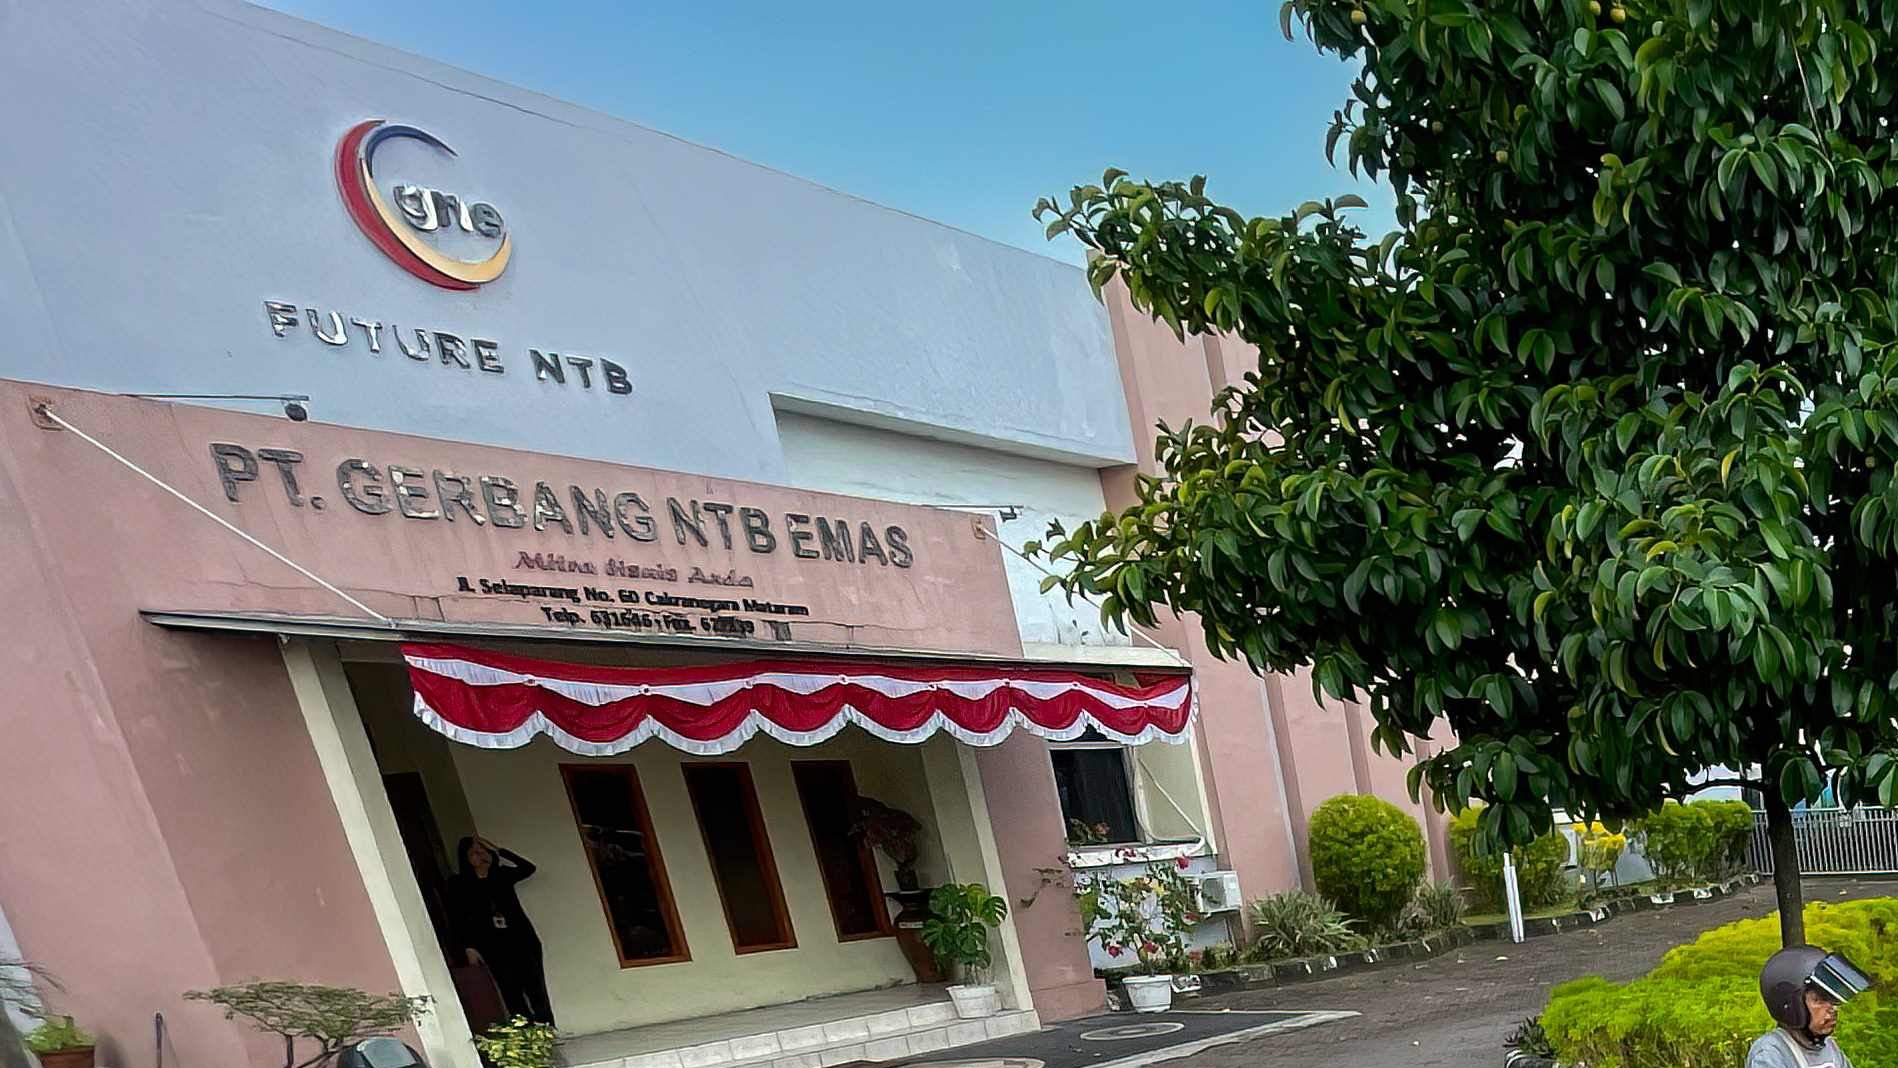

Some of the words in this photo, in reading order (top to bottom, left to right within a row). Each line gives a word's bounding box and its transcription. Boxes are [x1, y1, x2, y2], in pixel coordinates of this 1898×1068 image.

[264, 299, 505, 374] FUTURE
[529, 348, 633, 396] NTB
[208, 441, 327, 512] PT.
[335, 457, 659, 543] GERBANG
[666, 495, 777, 555] NTB
[786, 511, 915, 569] EMAS
[583, 586, 615, 602] No.
